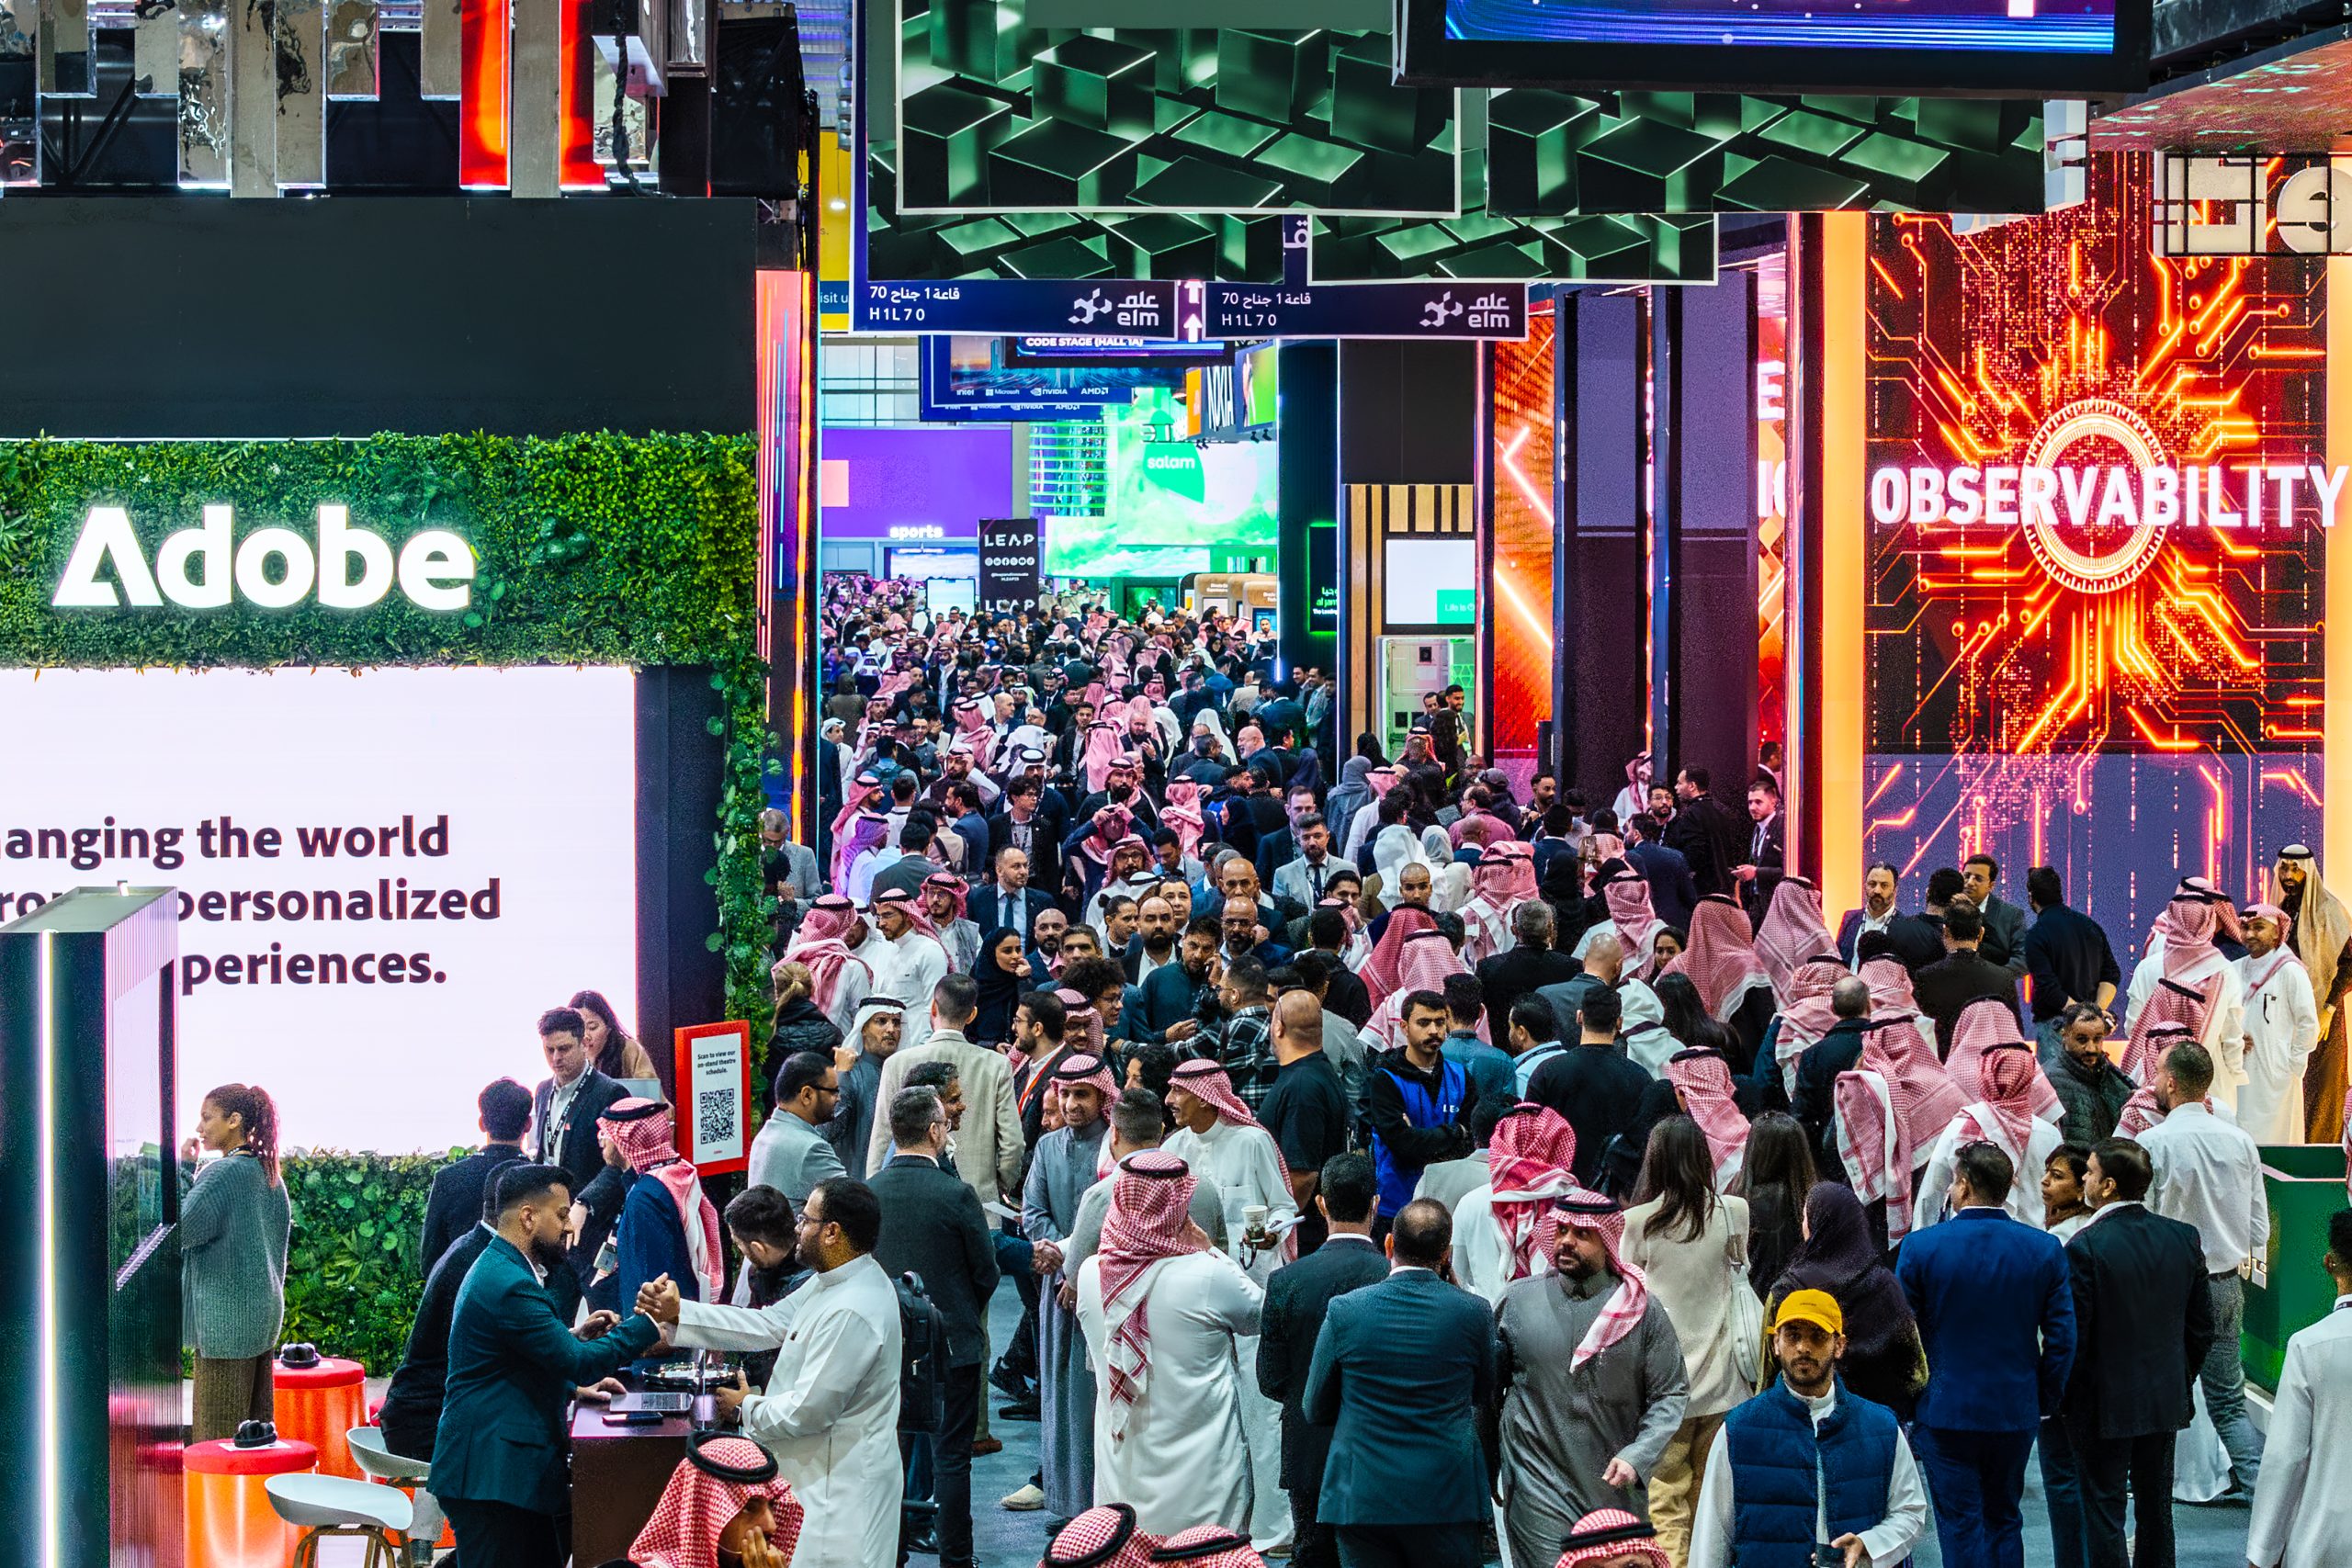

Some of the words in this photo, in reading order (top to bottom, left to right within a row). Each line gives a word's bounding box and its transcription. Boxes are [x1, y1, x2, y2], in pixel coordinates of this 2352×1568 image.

[820, 293, 838, 304] isit
[869, 286, 888, 299] 70
[890, 287, 921, 303] جناح
[924, 287, 931, 299] 1
[933, 287, 960, 300] قاعة
[1222, 292, 1238, 305] 70
[1276, 292, 1282, 305] 1
[1242, 292, 1272, 309] جناح
[1284, 293, 1311, 306] قاعة
[1116, 309, 1159, 326] elm
[1467, 310, 1510, 328] elm
[1025, 337, 1057, 346] CODE
[1058, 337, 1092, 347] STAGE
[1094, 338, 1126, 347] (HALL
[1148, 456, 1195, 469] salam
[1871, 465, 2350, 528] OBSERVABILITY
[889, 525, 944, 540] sports
[984, 534, 1035, 547] LEAP
[51, 504, 476, 610] Adobe
[0, 816, 184, 871] anging
[196, 816, 282, 859] the
[296, 814, 449, 858] world
[182, 942, 447, 996] periences.
